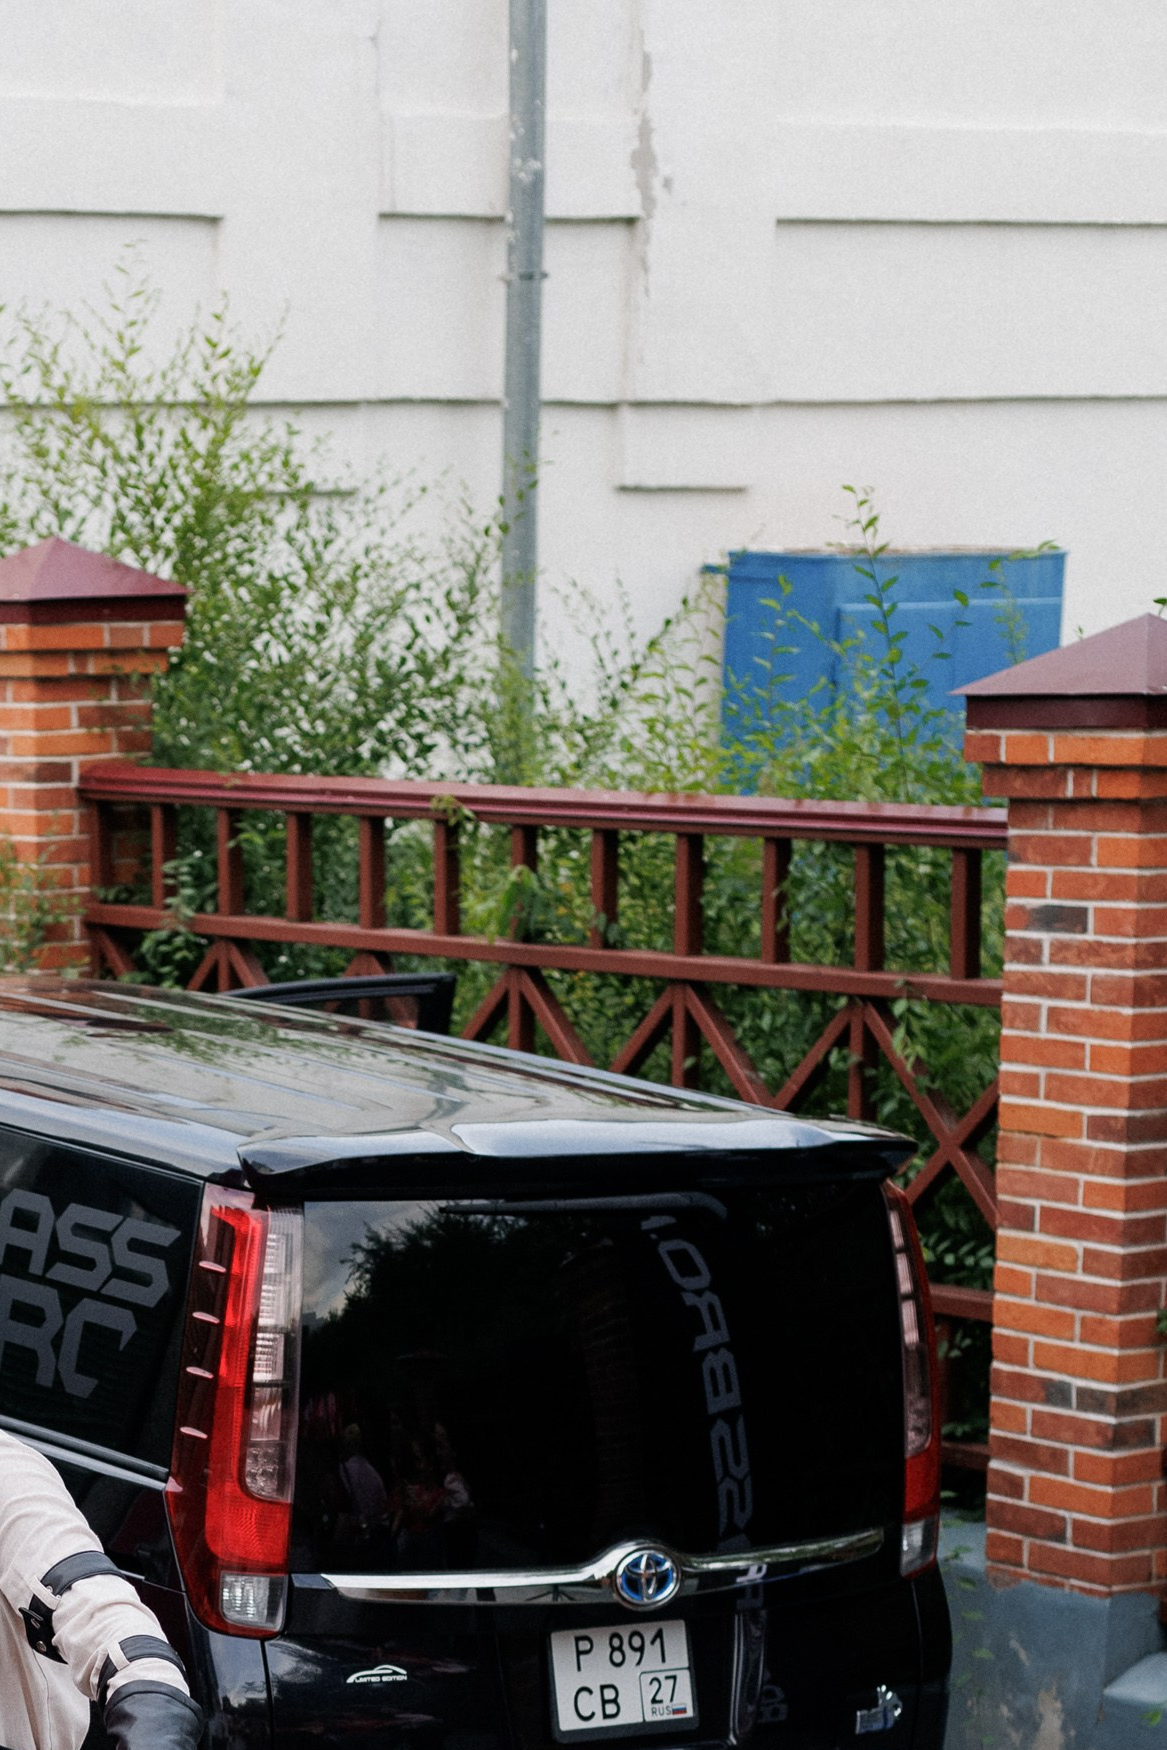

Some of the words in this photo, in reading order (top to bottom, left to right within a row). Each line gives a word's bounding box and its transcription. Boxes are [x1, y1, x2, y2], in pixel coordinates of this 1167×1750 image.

[608, 1627, 666, 1668] 891
[649, 1675, 678, 1705] 27
[651, 1705, 671, 1718] RUS
